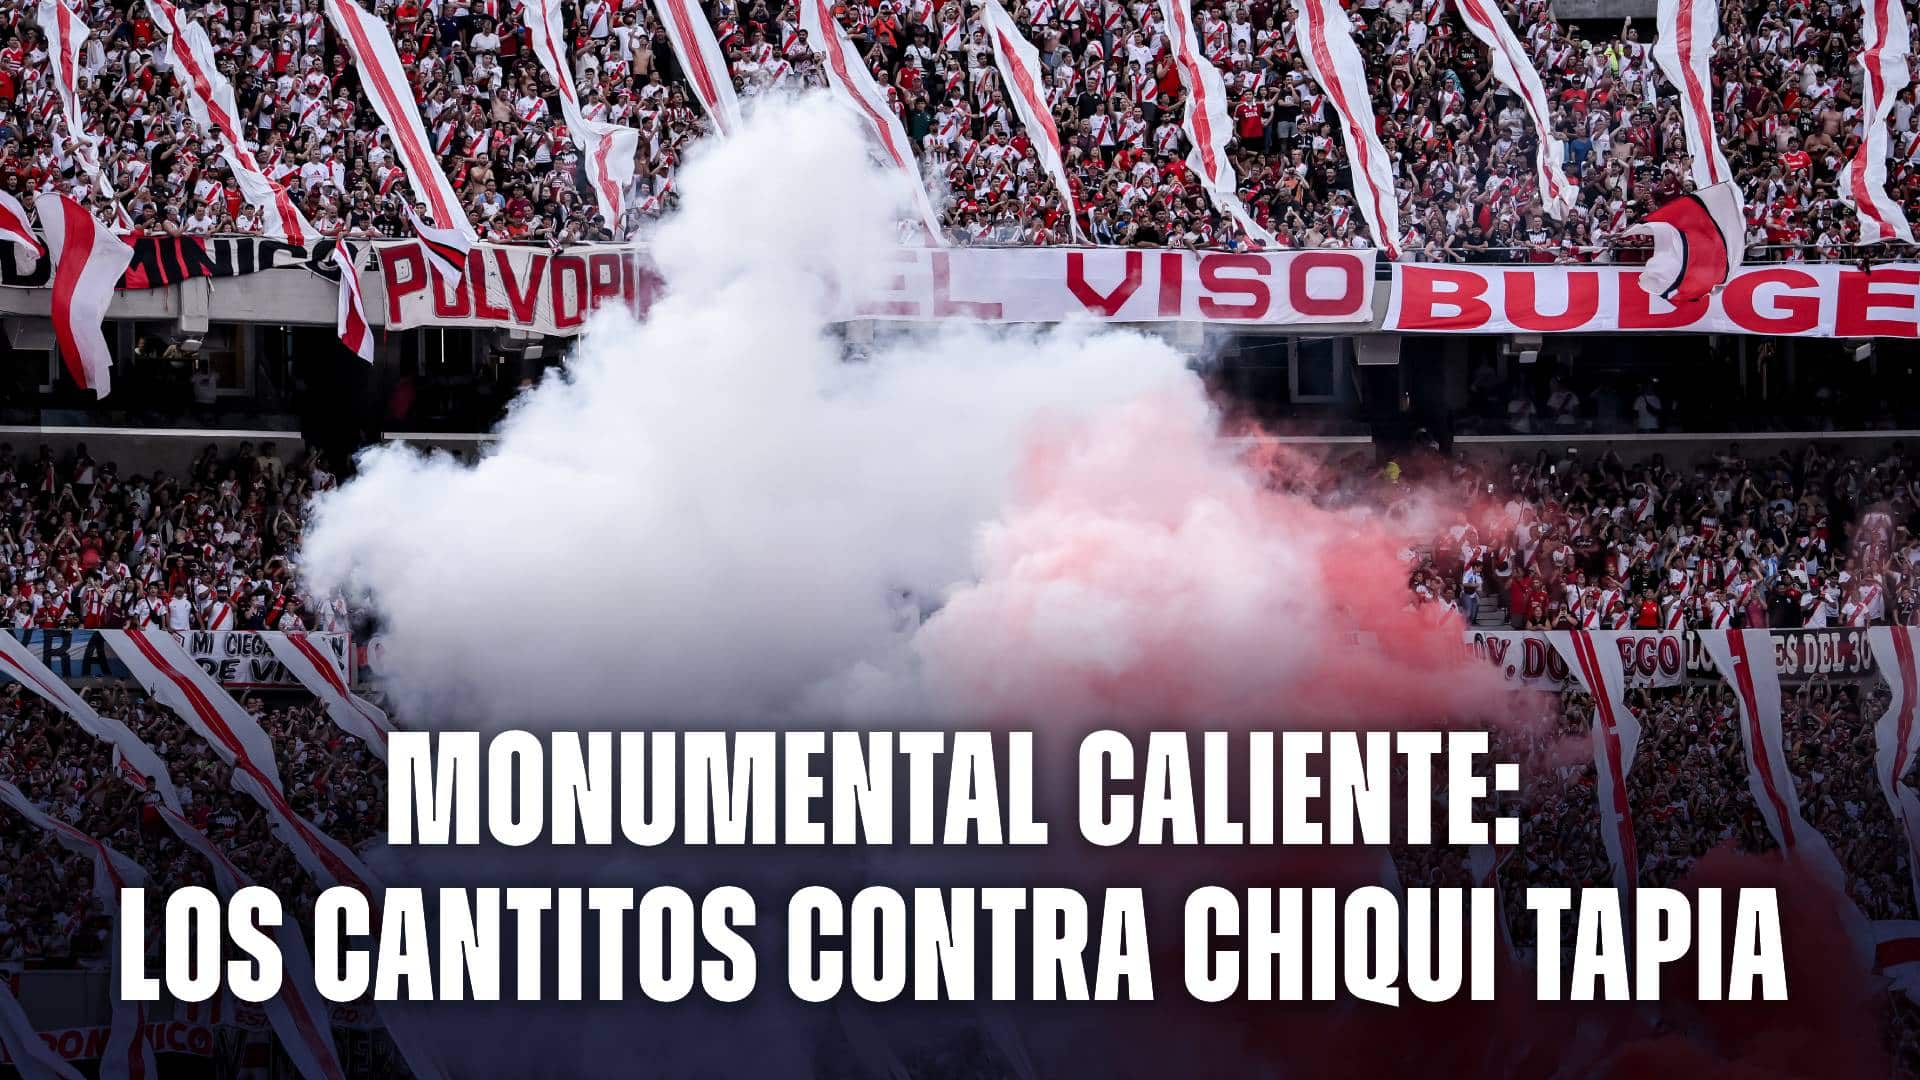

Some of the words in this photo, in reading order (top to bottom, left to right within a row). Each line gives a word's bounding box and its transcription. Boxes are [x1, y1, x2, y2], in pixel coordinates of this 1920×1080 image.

[1066, 251, 1357, 319] VISO
[1396, 264, 1919, 337] BUDGE
[192, 633, 214, 654] MI
[1803, 632, 1845, 673] DEL
